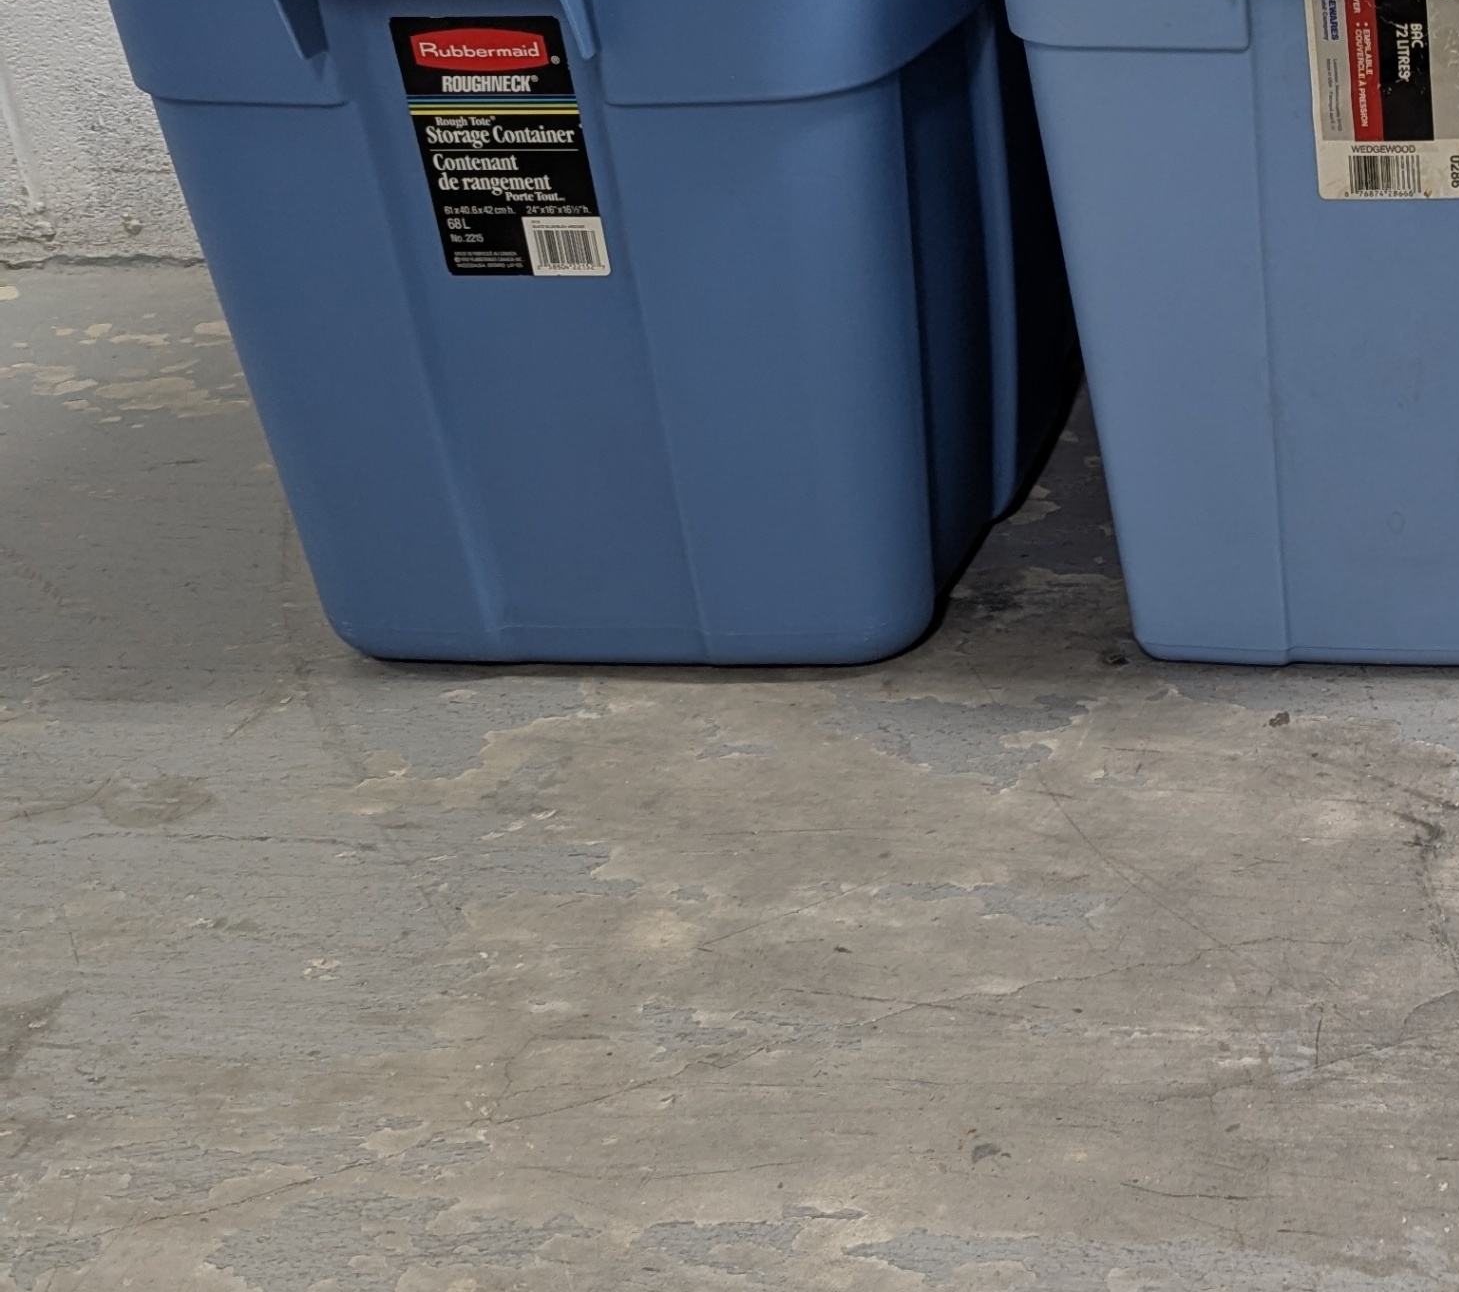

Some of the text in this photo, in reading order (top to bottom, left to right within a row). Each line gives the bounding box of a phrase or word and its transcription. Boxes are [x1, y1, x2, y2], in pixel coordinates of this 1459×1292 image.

[1410, 23, 1424, 49] BAC
[418, 41, 540, 57] Rubbermaid
[1363, 28, 1374, 75] EMPILABLE
[1395, 22, 1412, 81] 72 LITRES
[1358, 88, 1369, 127] PRESSION
[435, 116, 468, 128] Rough
[425, 125, 575, 148] Storage Container
[1351, 145, 1416, 153] WEDGEWOOD
[433, 153, 519, 170] Contenant
[438, 172, 552, 196] de rangement
[505, 192, 533, 202] Porte
